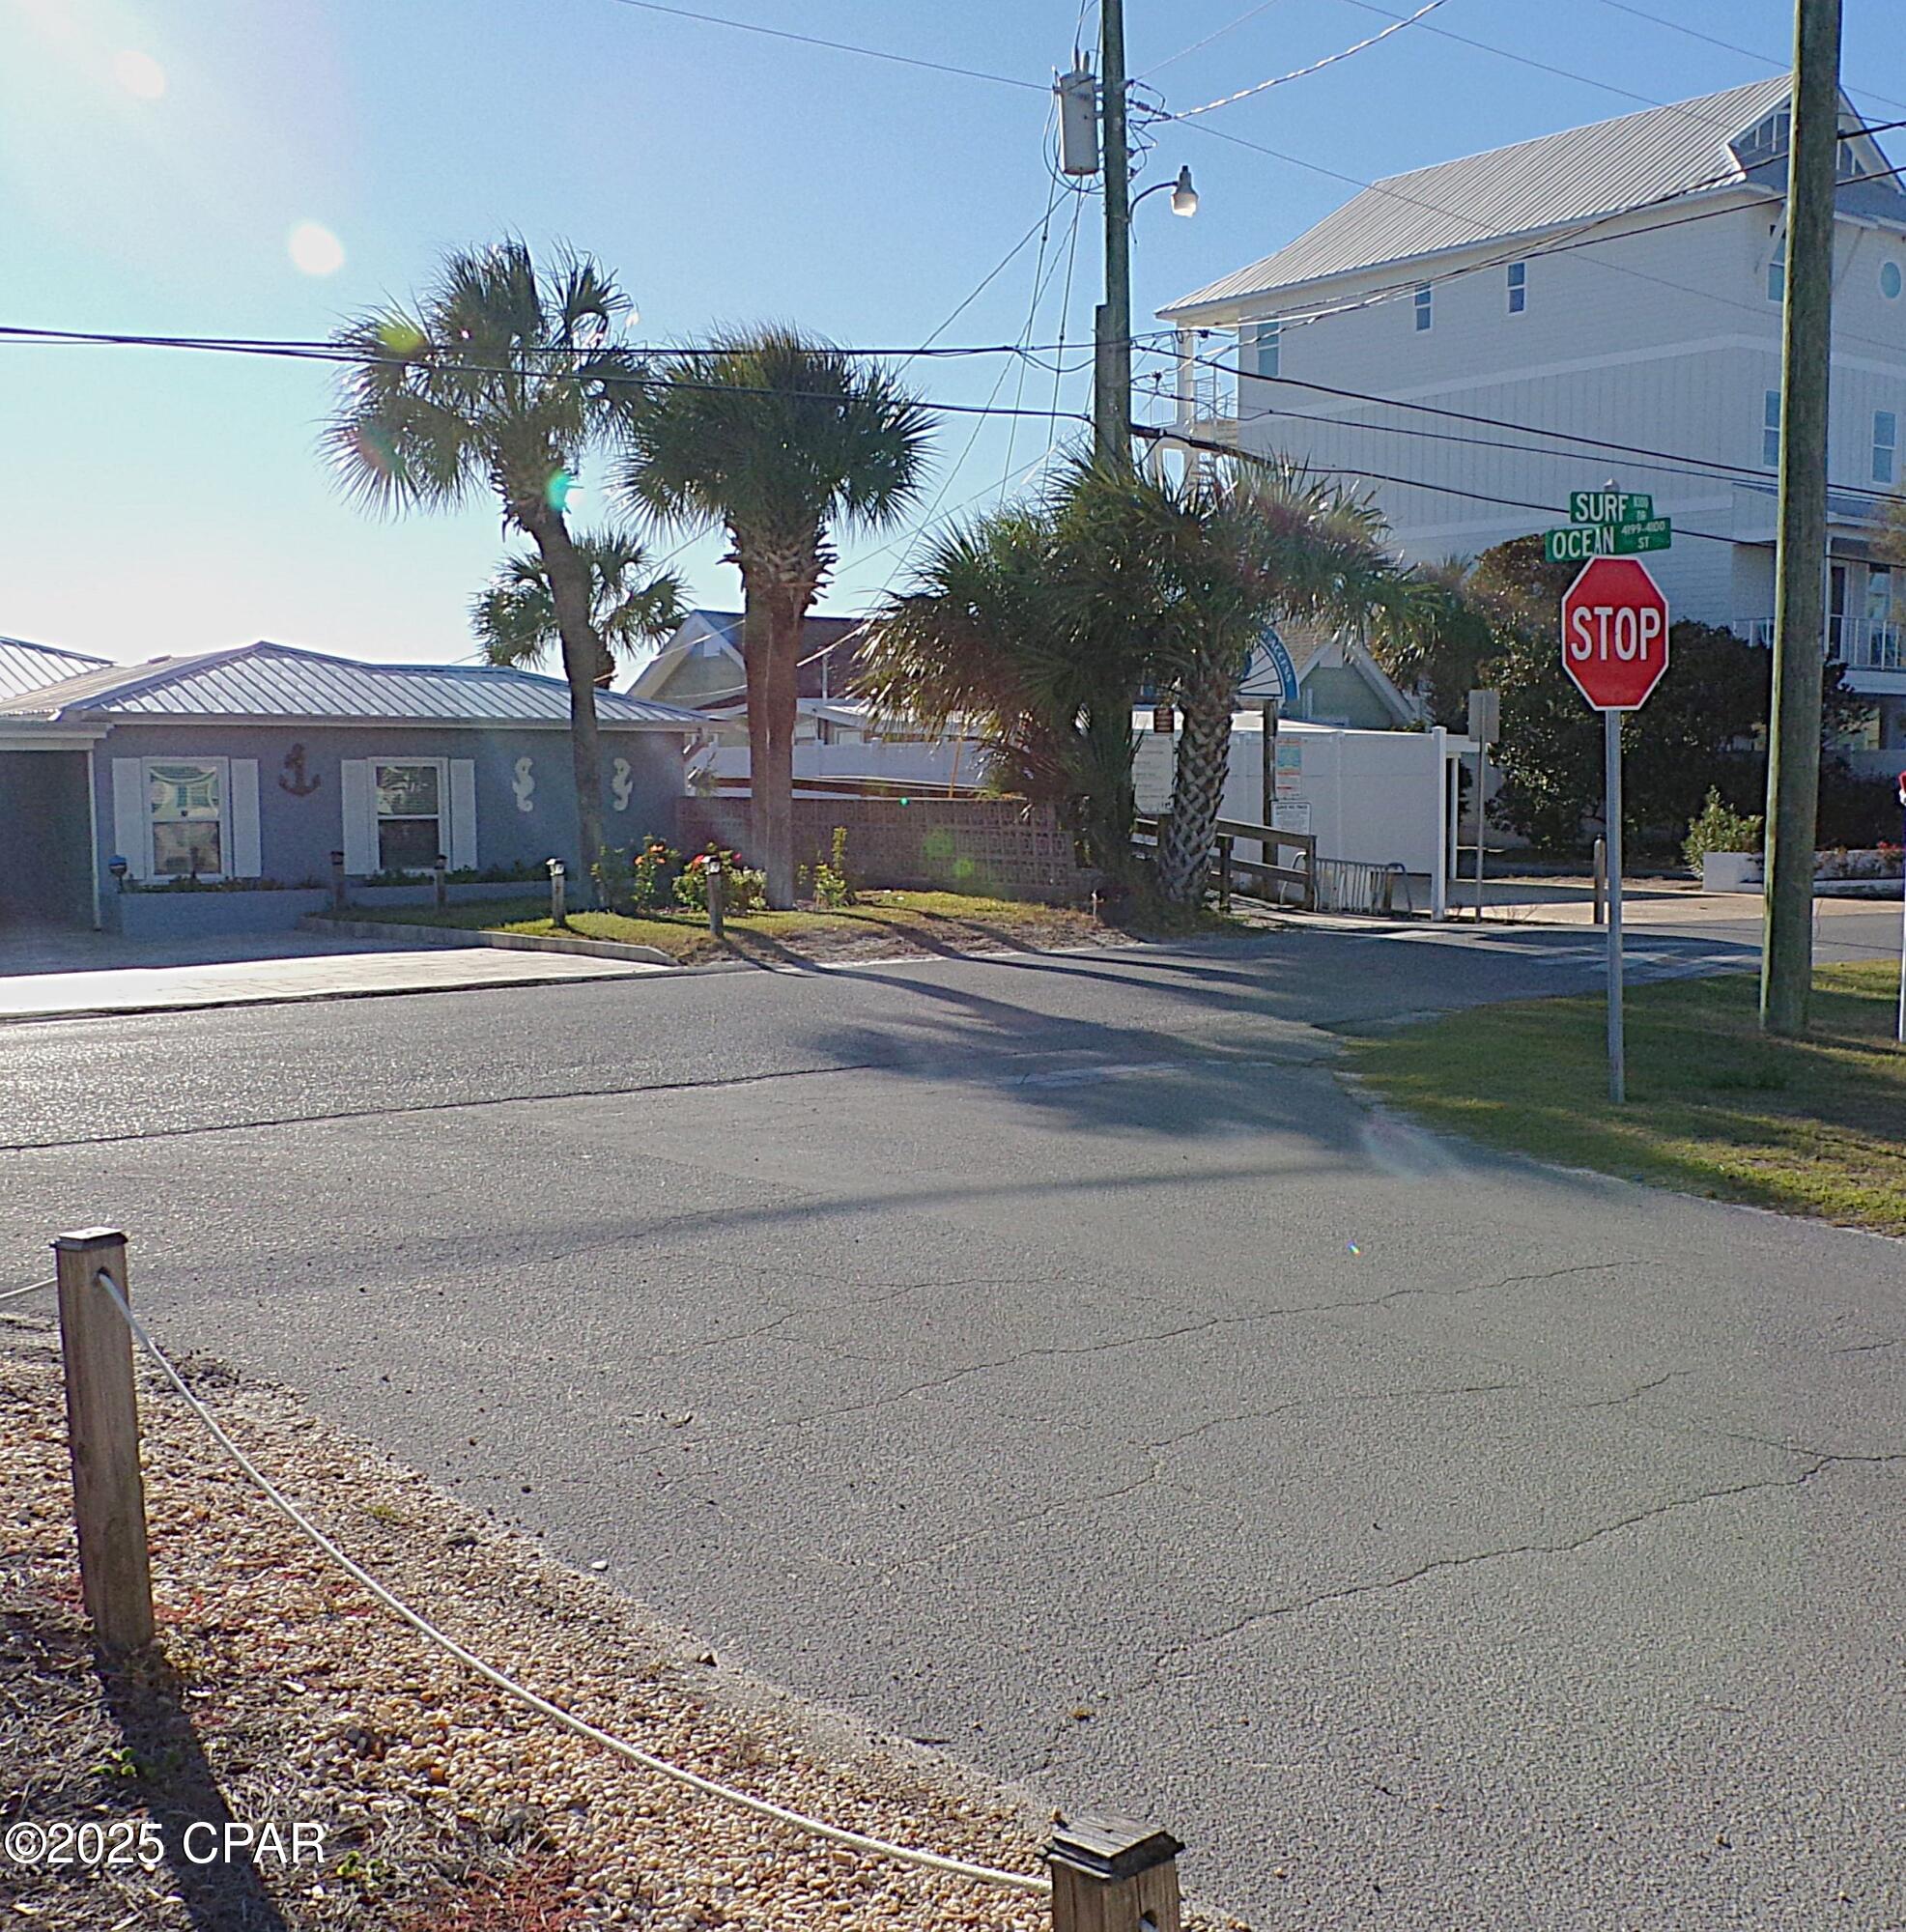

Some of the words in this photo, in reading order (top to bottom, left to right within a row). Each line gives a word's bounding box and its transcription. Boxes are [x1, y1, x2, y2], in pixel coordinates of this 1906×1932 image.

[1575, 493, 1629, 523] SURF
[1551, 526, 1614, 559] OCEAN
[1637, 536, 1650, 550] ST
[1570, 606, 1661, 661] STOP
